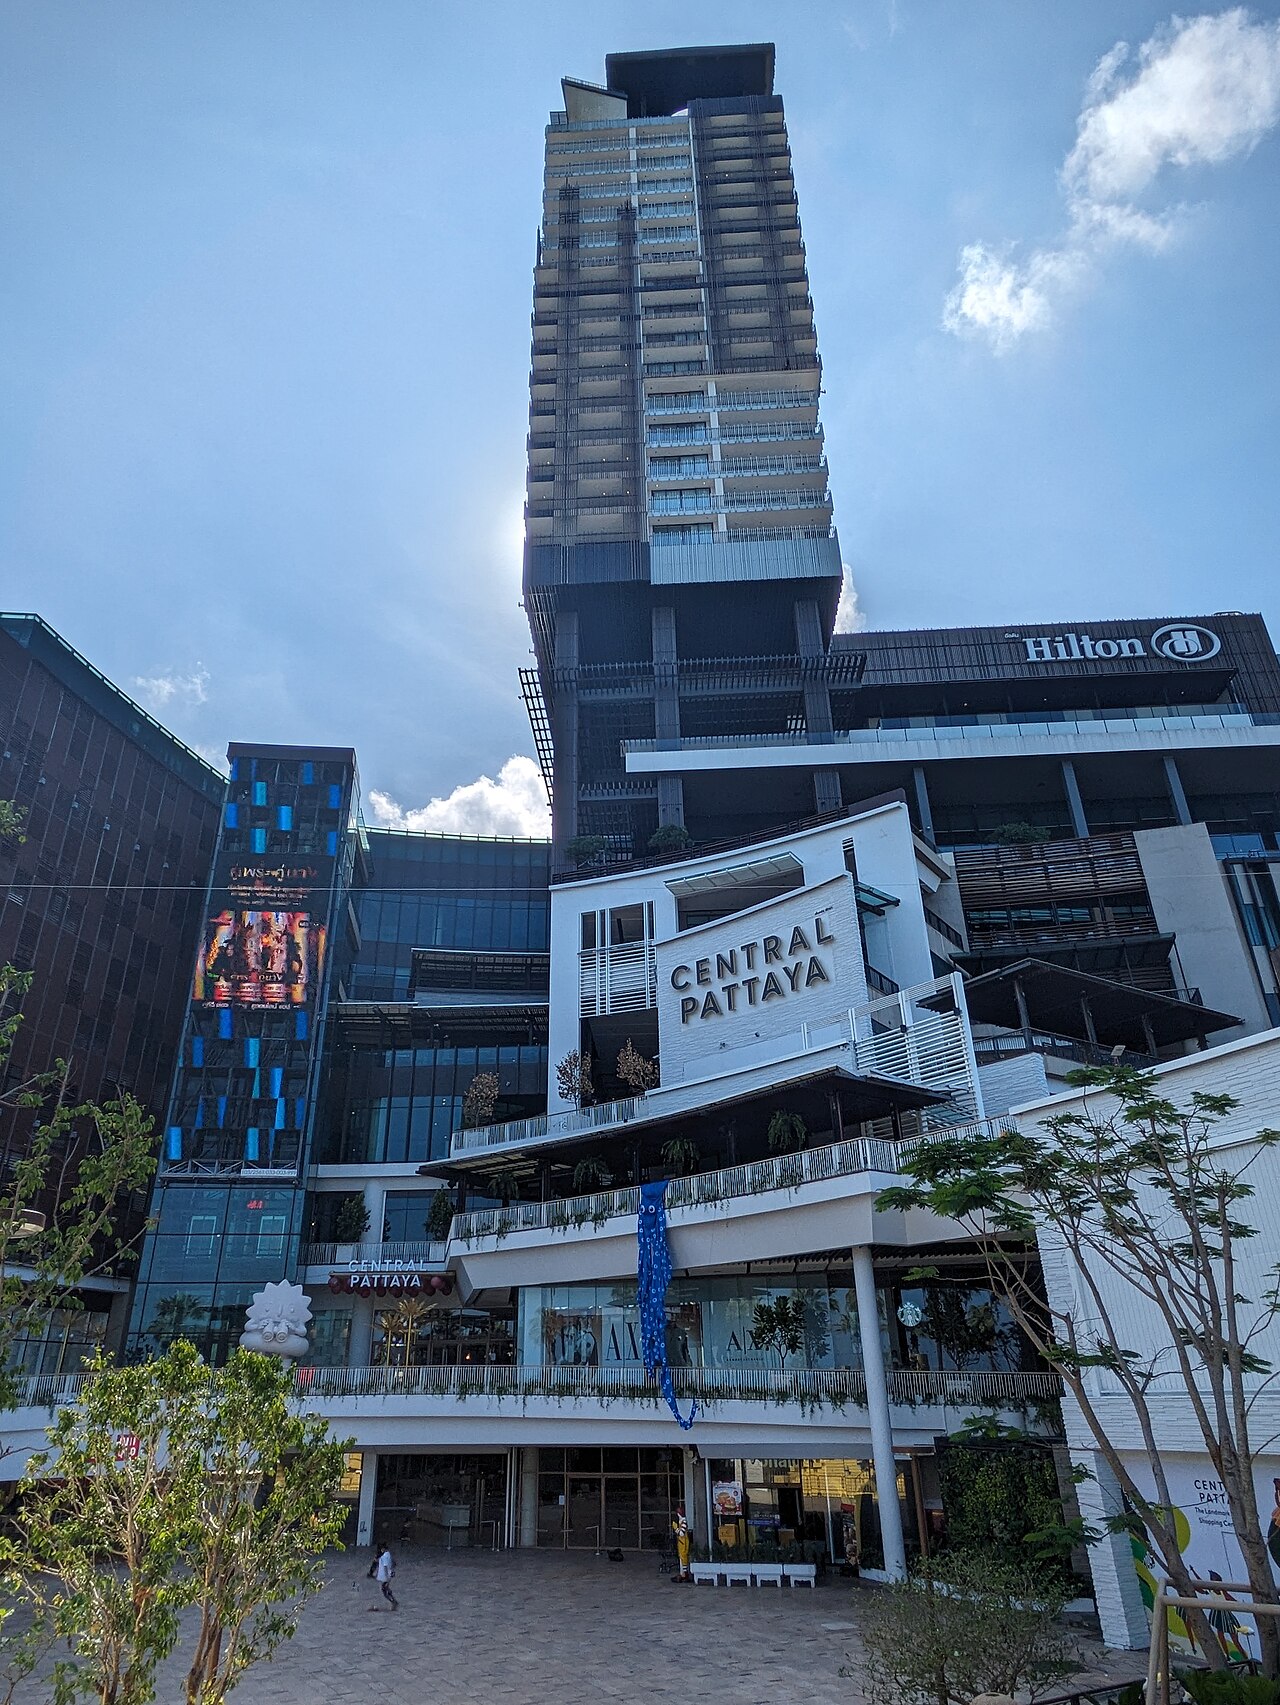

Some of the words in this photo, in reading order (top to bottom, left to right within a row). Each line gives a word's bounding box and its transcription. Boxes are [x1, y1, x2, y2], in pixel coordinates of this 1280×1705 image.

[1022, 633, 1147, 662] Hilton
[670, 917, 834, 990] CENTRAL
[680, 956, 829, 1024] PATTAYA
[348, 1259, 427, 1272] CENTRAL
[350, 1274, 421, 1287] PATTAYA
[1194, 1479, 1223, 1491] CENT
[1199, 1492, 1229, 1504] PATT
[1199, 1517, 1223, 1527] Shopping
